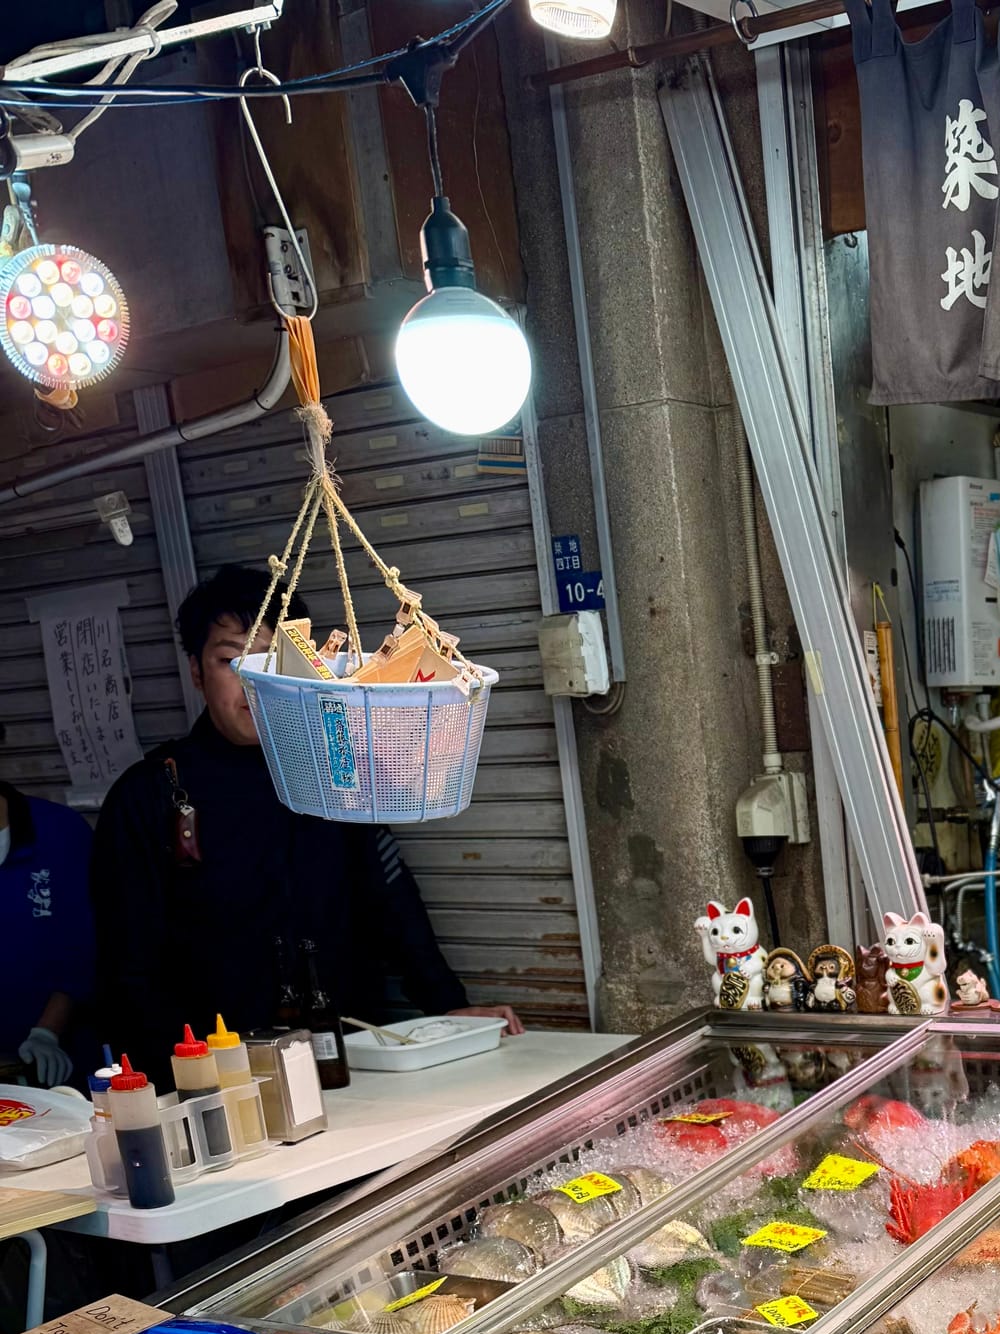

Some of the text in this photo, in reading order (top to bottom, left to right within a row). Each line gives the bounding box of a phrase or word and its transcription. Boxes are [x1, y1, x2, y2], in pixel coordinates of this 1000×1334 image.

[556, 555, 580, 571] 四丁目
[85, 1304, 135, 1331] Don't
